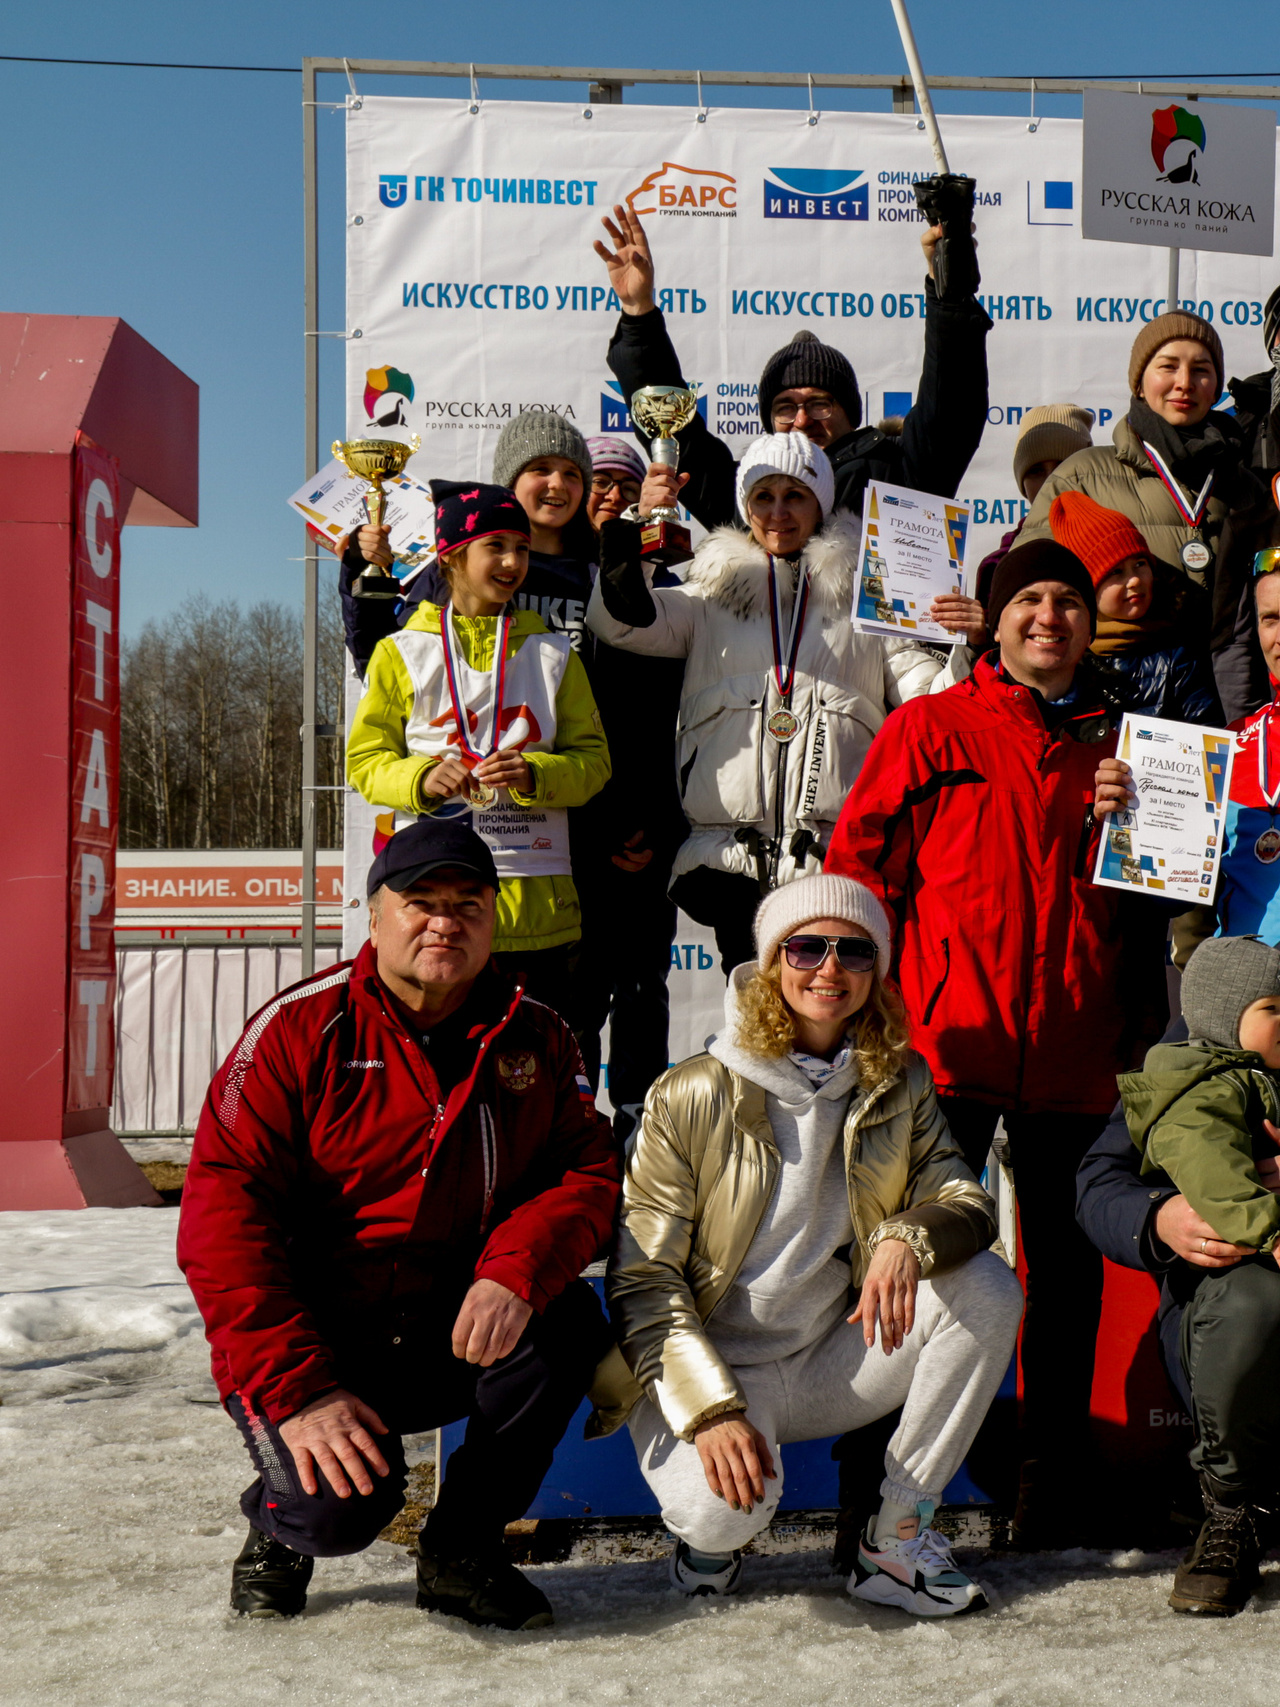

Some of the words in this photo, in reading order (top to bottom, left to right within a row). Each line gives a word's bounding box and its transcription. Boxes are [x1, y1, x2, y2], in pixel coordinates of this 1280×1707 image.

[414, 175, 445, 202] ГК
[452, 177, 598, 206] ТОЧИНВЕСТ
[659, 185, 737, 209] БАРС
[659, 209, 690, 217] ГРУППА
[692, 208, 737, 218] КОМПАНИЙ
[770, 198, 863, 217] ИНВЕСТ
[1101, 188, 1190, 216] РУССКАЯ
[1197, 199, 1256, 223] КОЖА
[1129, 215, 1170, 228] группа
[402, 282, 549, 310] ИСКУССТВО
[732, 289, 874, 318] ИСКУССТВО
[425, 401, 512, 418] РУССКАЯ
[425, 422, 464, 430] группа
[890, 517, 945, 539] ГРАМОТА
[912, 553, 933, 563] место
[1141, 755, 1202, 776] ГРАМОТА
[79, 478, 115, 1077] СТАРТ
[803, 775, 819, 814] THEY
[1163, 800, 1186, 809] место
[478, 813, 548, 824] ПРОМЫШЛЕННАЯ
[478, 825, 530, 835] КОМПАНИЯ
[125, 878, 237, 898] ЗНАНИЕ.
